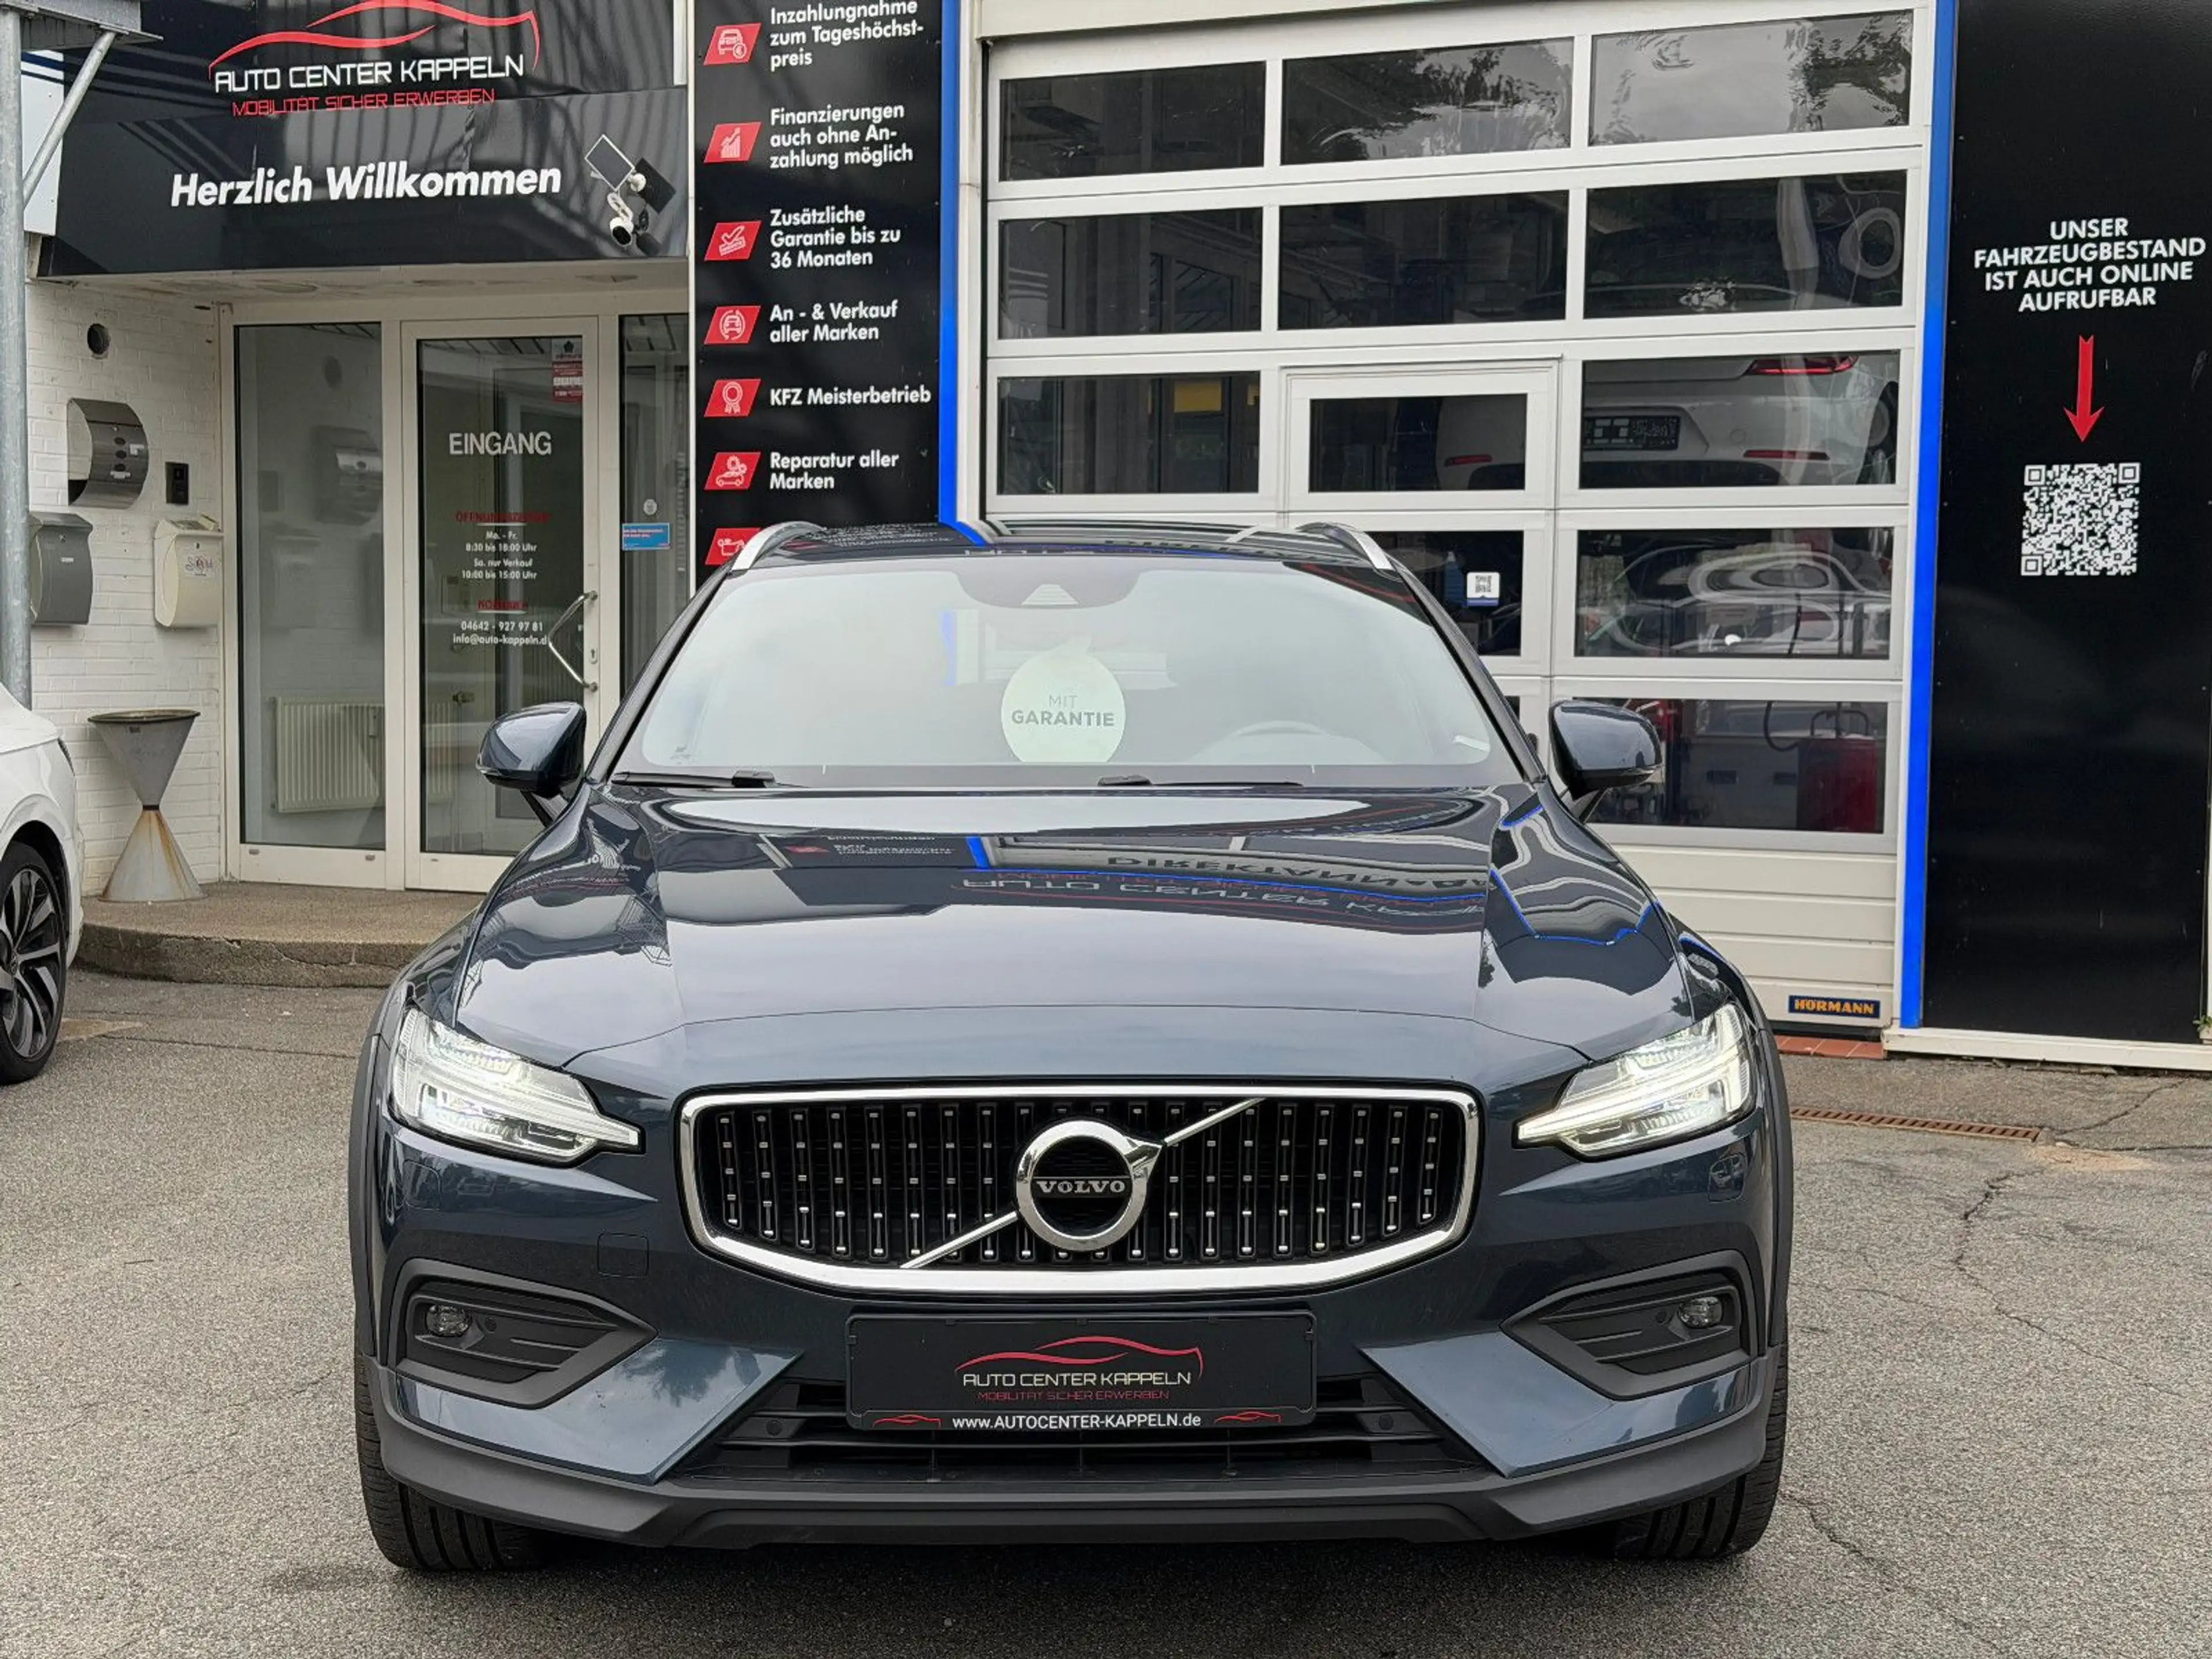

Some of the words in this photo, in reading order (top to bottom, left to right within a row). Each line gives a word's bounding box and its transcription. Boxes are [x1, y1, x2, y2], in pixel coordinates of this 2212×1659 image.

[771, 0, 918, 24] Inzahlungnahme
[770, 31, 806, 46] zum
[812, 18, 924, 46] Tageshöchst-
[771, 47, 812, 72] preis
[215, 67, 279, 93] AUTO
[289, 61, 392, 88] CENTER
[401, 54, 524, 82] KAPPELN
[325, 93, 388, 112] SICHER
[393, 88, 495, 108] ERWERBEN
[771, 104, 904, 126] Finanzierungen
[770, 127, 810, 147] auch
[817, 126, 860, 145] ohne
[866, 125, 897, 142] An-
[770, 148, 838, 169] zahlung
[844, 144, 913, 168] möglich
[171, 166, 312, 207] Herzlich
[327, 161, 561, 201] Willkommen
[770, 205, 865, 226] Zusätzliche
[771, 229, 845, 247] Garantie
[851, 226, 875, 244] bis
[881, 229, 901, 243] zu
[2050, 217, 2128, 240] UNSER
[771, 252, 791, 269] 36
[798, 251, 873, 267] Monaten
[1974, 237, 2206, 268] FAHRZEUGBESTAND
[1985, 271, 2017, 291] IST
[2023, 267, 2092, 289] AUCH
[2101, 261, 2193, 283] ONLINE
[2018, 288, 2156, 312] AUFRUFBAR
[770, 305, 794, 322] An
[812, 303, 825, 320] &
[830, 300, 898, 320] Verkauf
[770, 325, 809, 342] aller
[813, 324, 878, 341] Marken
[771, 388, 802, 406] KFZ
[808, 385, 931, 404] Meisterbetrieb
[449, 431, 551, 455] EINGANG
[771, 452, 855, 472] Reparatur
[859, 450, 899, 467] aller
[770, 472, 834, 490] Marken
[485, 543, 495, 551] bis
[522, 543, 537, 551] Uhr
[474, 558, 485, 567] Sa.
[485, 570, 495, 578] bis
[522, 570, 537, 578] Uhr
[461, 620, 489, 630] 04642
[499, 621, 516, 631] 927
[518, 622, 530, 631] 97
[532, 622, 543, 631] 81
[1048, 695, 1078, 708] MIT
[1012, 710, 1115, 727] GARANTIE
[1037, 1180, 1126, 1194] VOLVO
[963, 1374, 1016, 1387] AUTO
[1020, 1373, 1097, 1387] CENTER
[1101, 1372, 1191, 1385] KAPPELN
[1047, 1391, 1093, 1400] SICHER
[1096, 1389, 1169, 1400] ERWERBEN
[952, 1412, 1202, 1429] www.AUTOCENTER-KAPPELN.de
